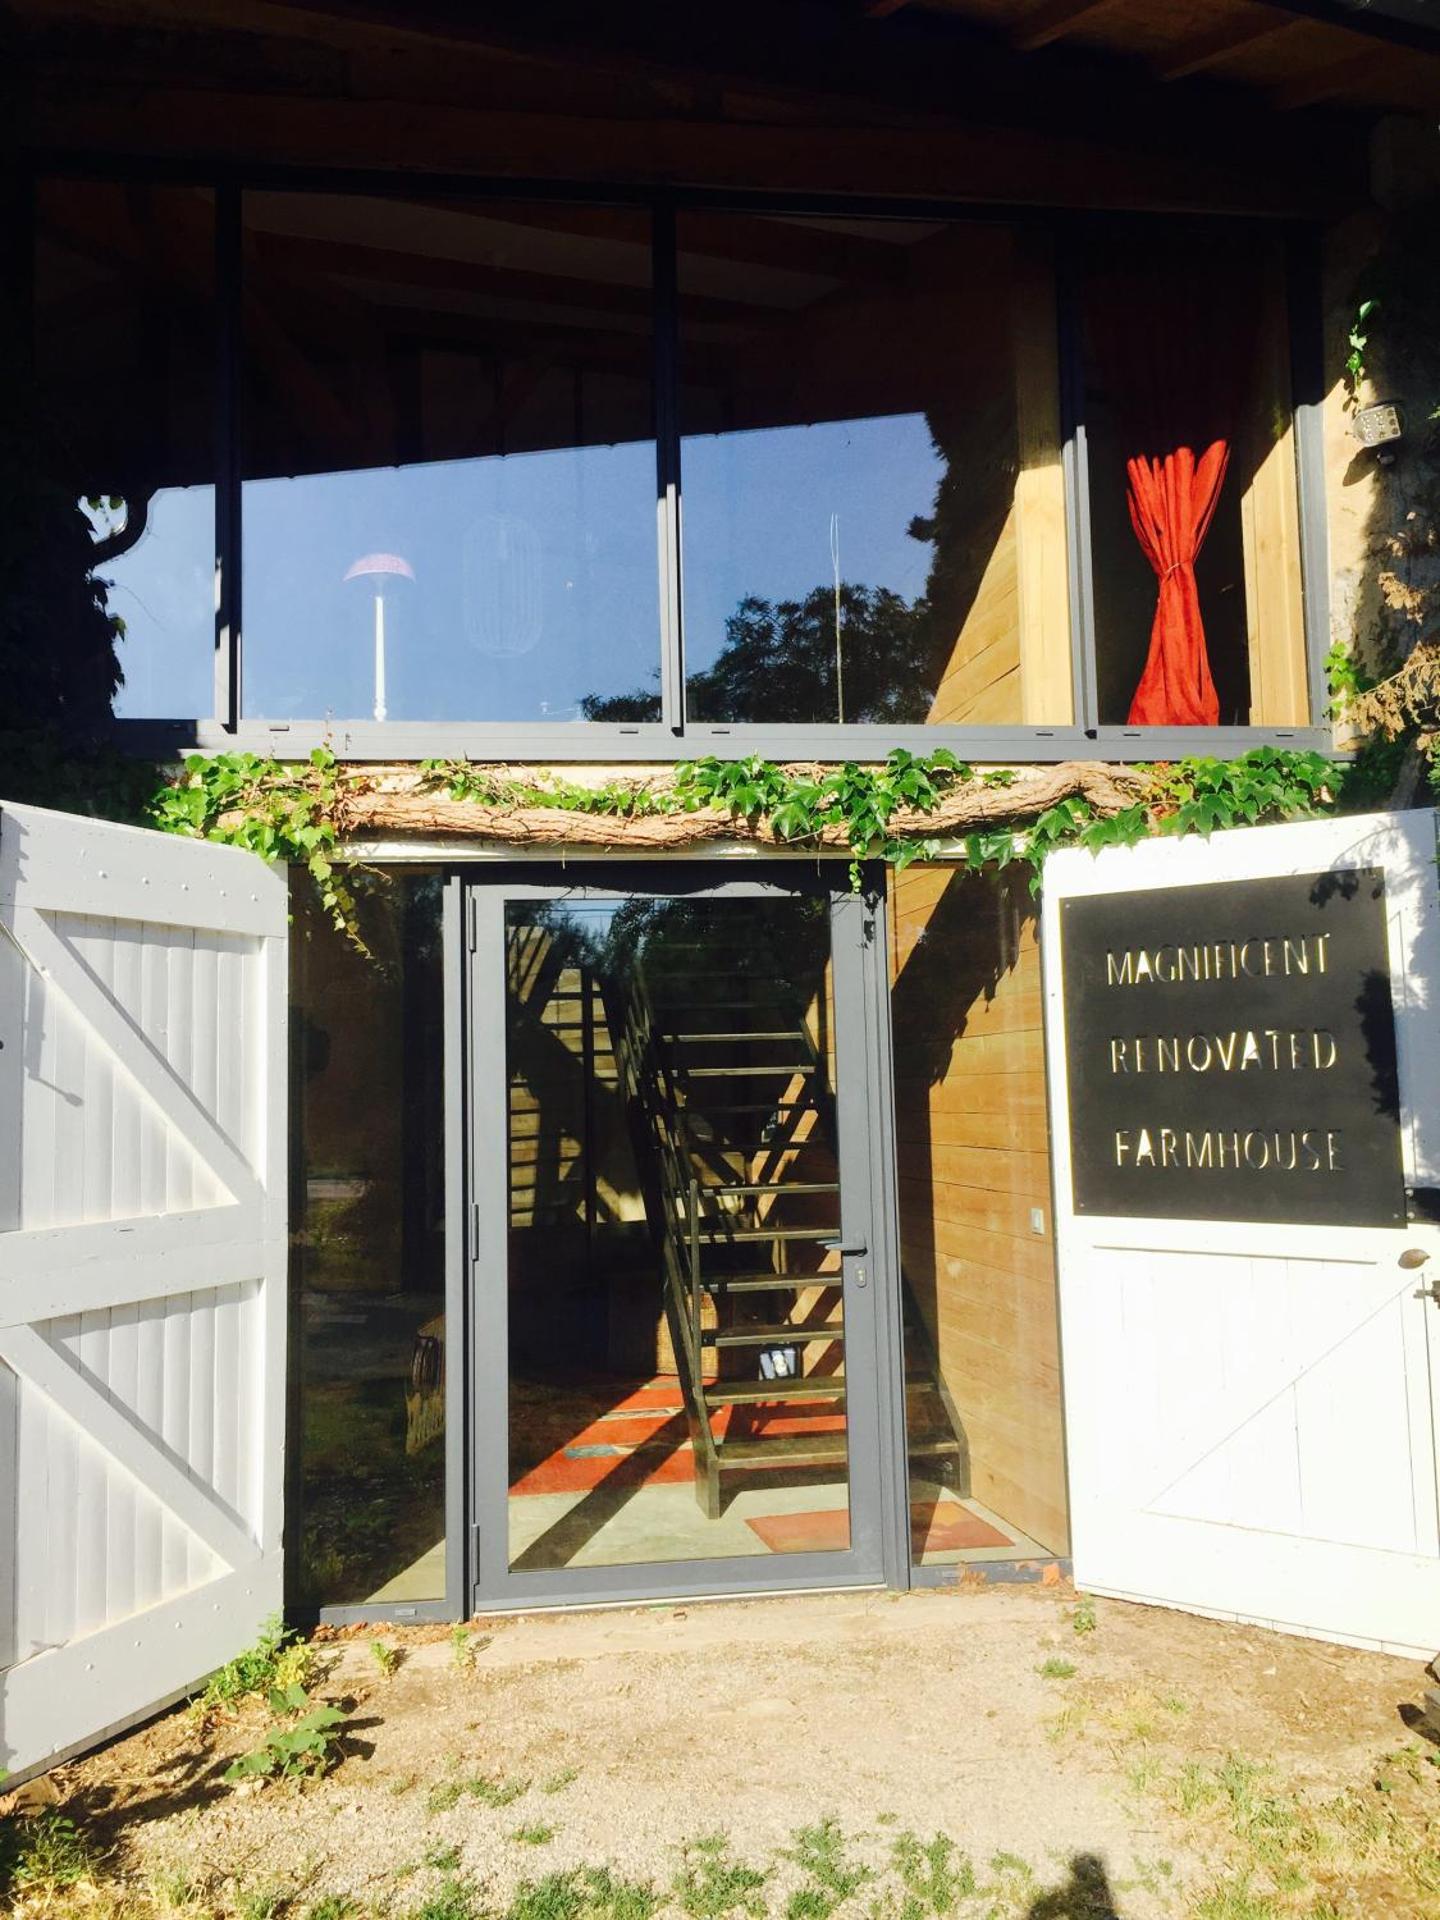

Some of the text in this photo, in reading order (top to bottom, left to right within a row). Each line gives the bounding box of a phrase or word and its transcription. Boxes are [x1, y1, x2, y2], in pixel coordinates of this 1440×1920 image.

[1106, 932, 1331, 986] MAGNIFICENT
[1110, 1029, 1337, 1074] RENOVATED
[1115, 1128, 1345, 1171] FARMHOUSE
